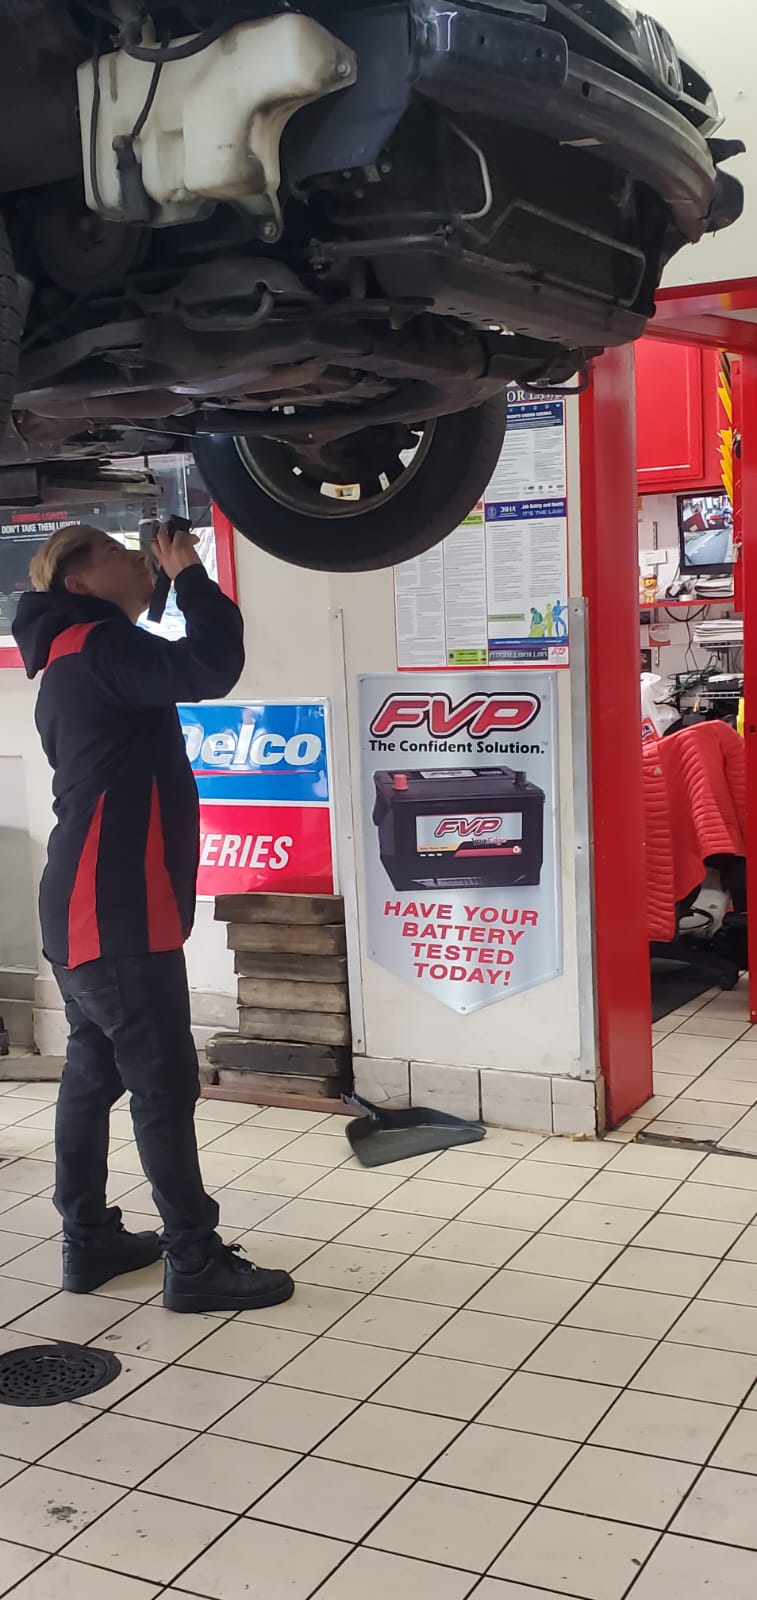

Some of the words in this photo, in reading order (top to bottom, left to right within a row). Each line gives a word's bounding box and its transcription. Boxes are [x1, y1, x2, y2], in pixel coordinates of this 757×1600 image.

[1, 524, 20, 534] DON'T
[21, 523, 37, 533] TAKE
[38, 522, 55, 532] THEM
[371, 692, 541, 739] FVP
[369, 740, 396, 752] The
[399, 740, 473, 753] Confident
[476, 741, 545, 754] Solution.
[434, 817, 502, 837] FVP
[199, 833, 294, 869] ERIES
[384, 901, 453, 920] HAVE
[463, 905, 539, 927] YOUR
[402, 922, 525, 945] BATTERY
[411, 943, 514, 965] TESTED
[414, 963, 511, 986] TODAY!
